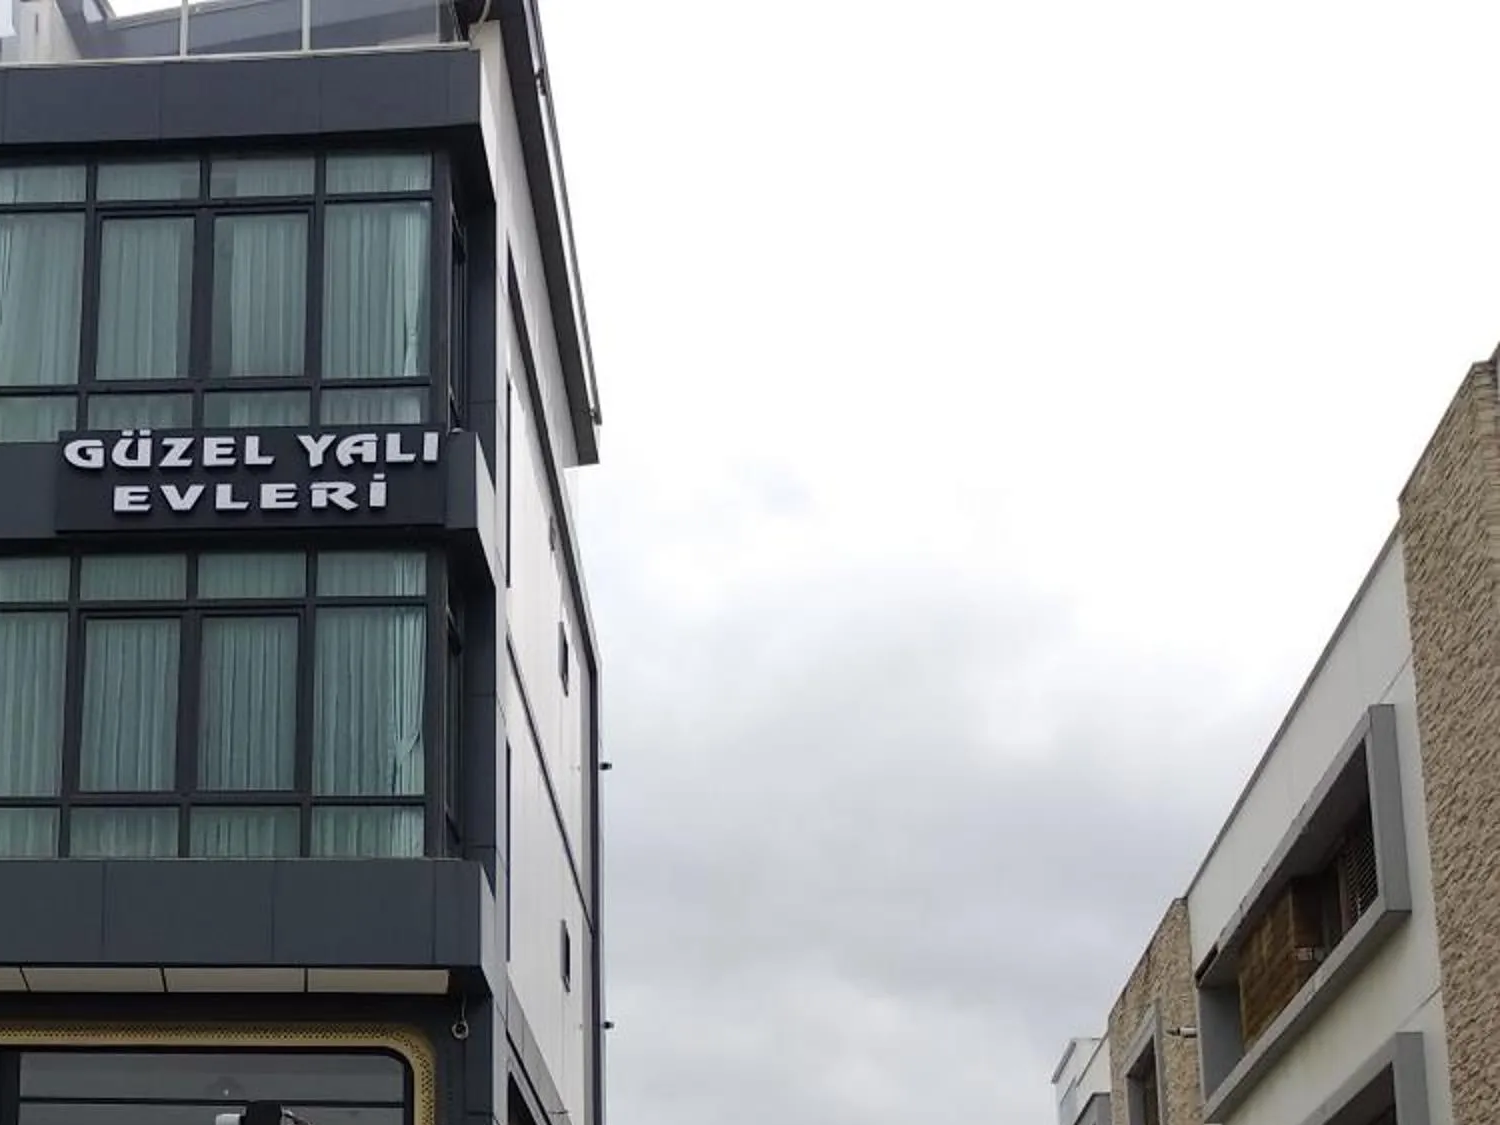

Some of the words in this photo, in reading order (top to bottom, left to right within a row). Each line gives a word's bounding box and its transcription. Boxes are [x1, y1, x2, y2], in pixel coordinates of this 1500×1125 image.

[63, 430, 275, 469] GÜZEL
[297, 432, 439, 467] YALI
[113, 473, 387, 512] EVLERİ
